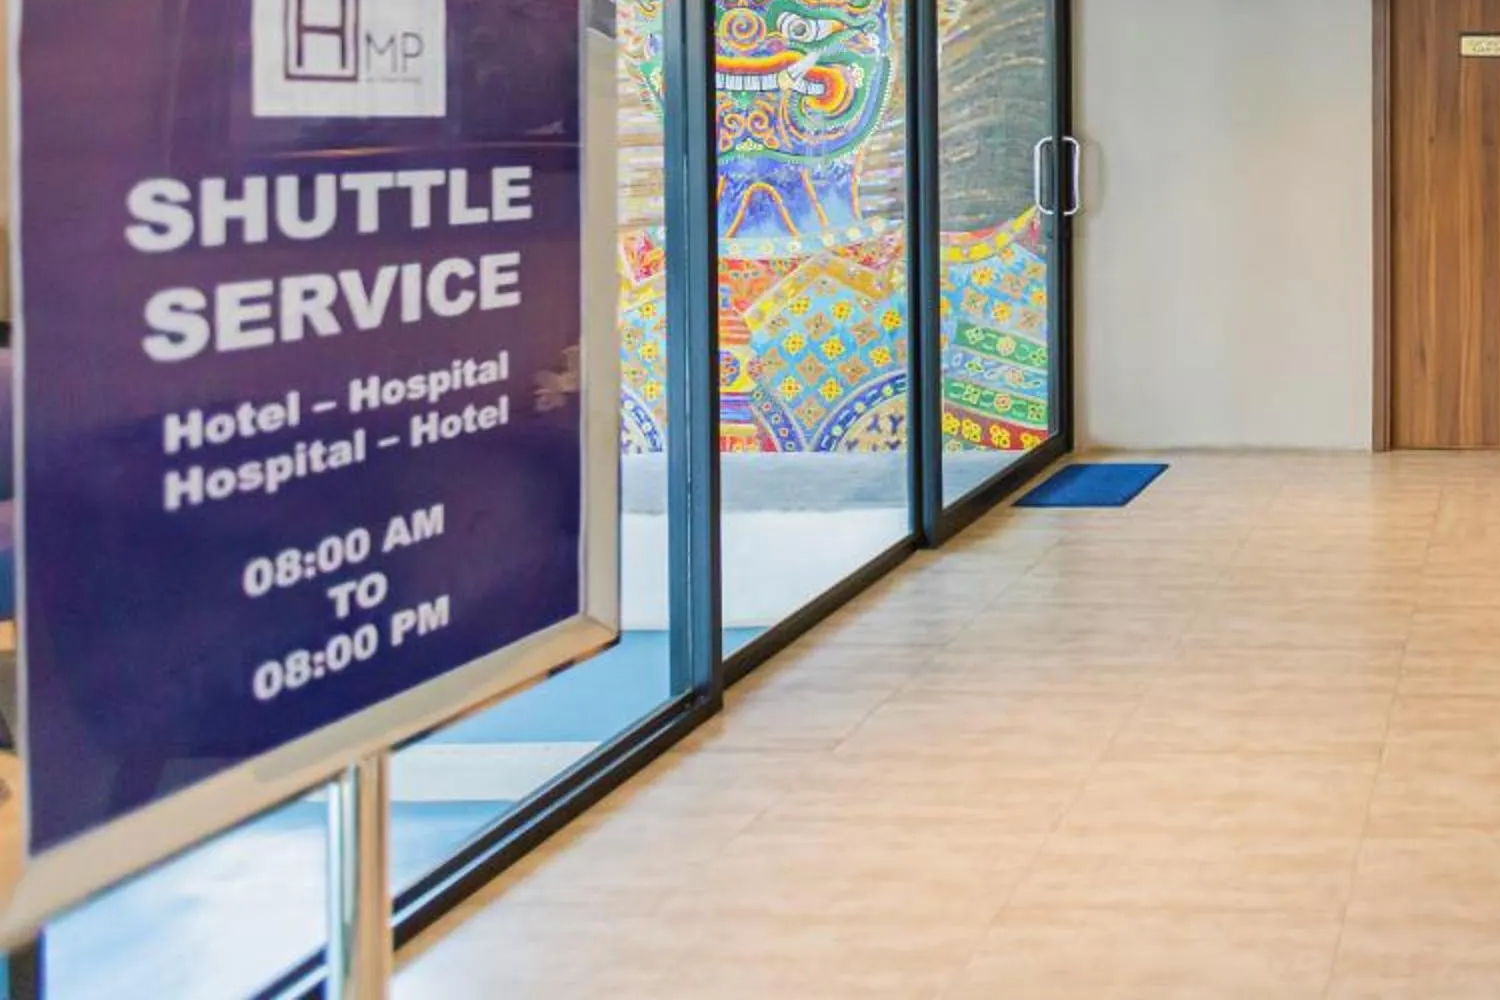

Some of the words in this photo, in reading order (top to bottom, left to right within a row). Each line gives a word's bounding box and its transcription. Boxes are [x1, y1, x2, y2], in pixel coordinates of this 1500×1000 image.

[125, 165, 533, 253] SHUTTLE
[143, 252, 522, 362] SERVICE
[163, 390, 301, 455] Hotel
[349, 350, 509, 413] Hospital
[163, 428, 367, 512] Hospital
[410, 395, 509, 448] Hotel
[243, 528, 371, 598] 08:00
[381, 503, 446, 553] AM
[327, 572, 388, 619] TO
[253, 624, 379, 700] 08:00
[390, 595, 450, 647] PM
